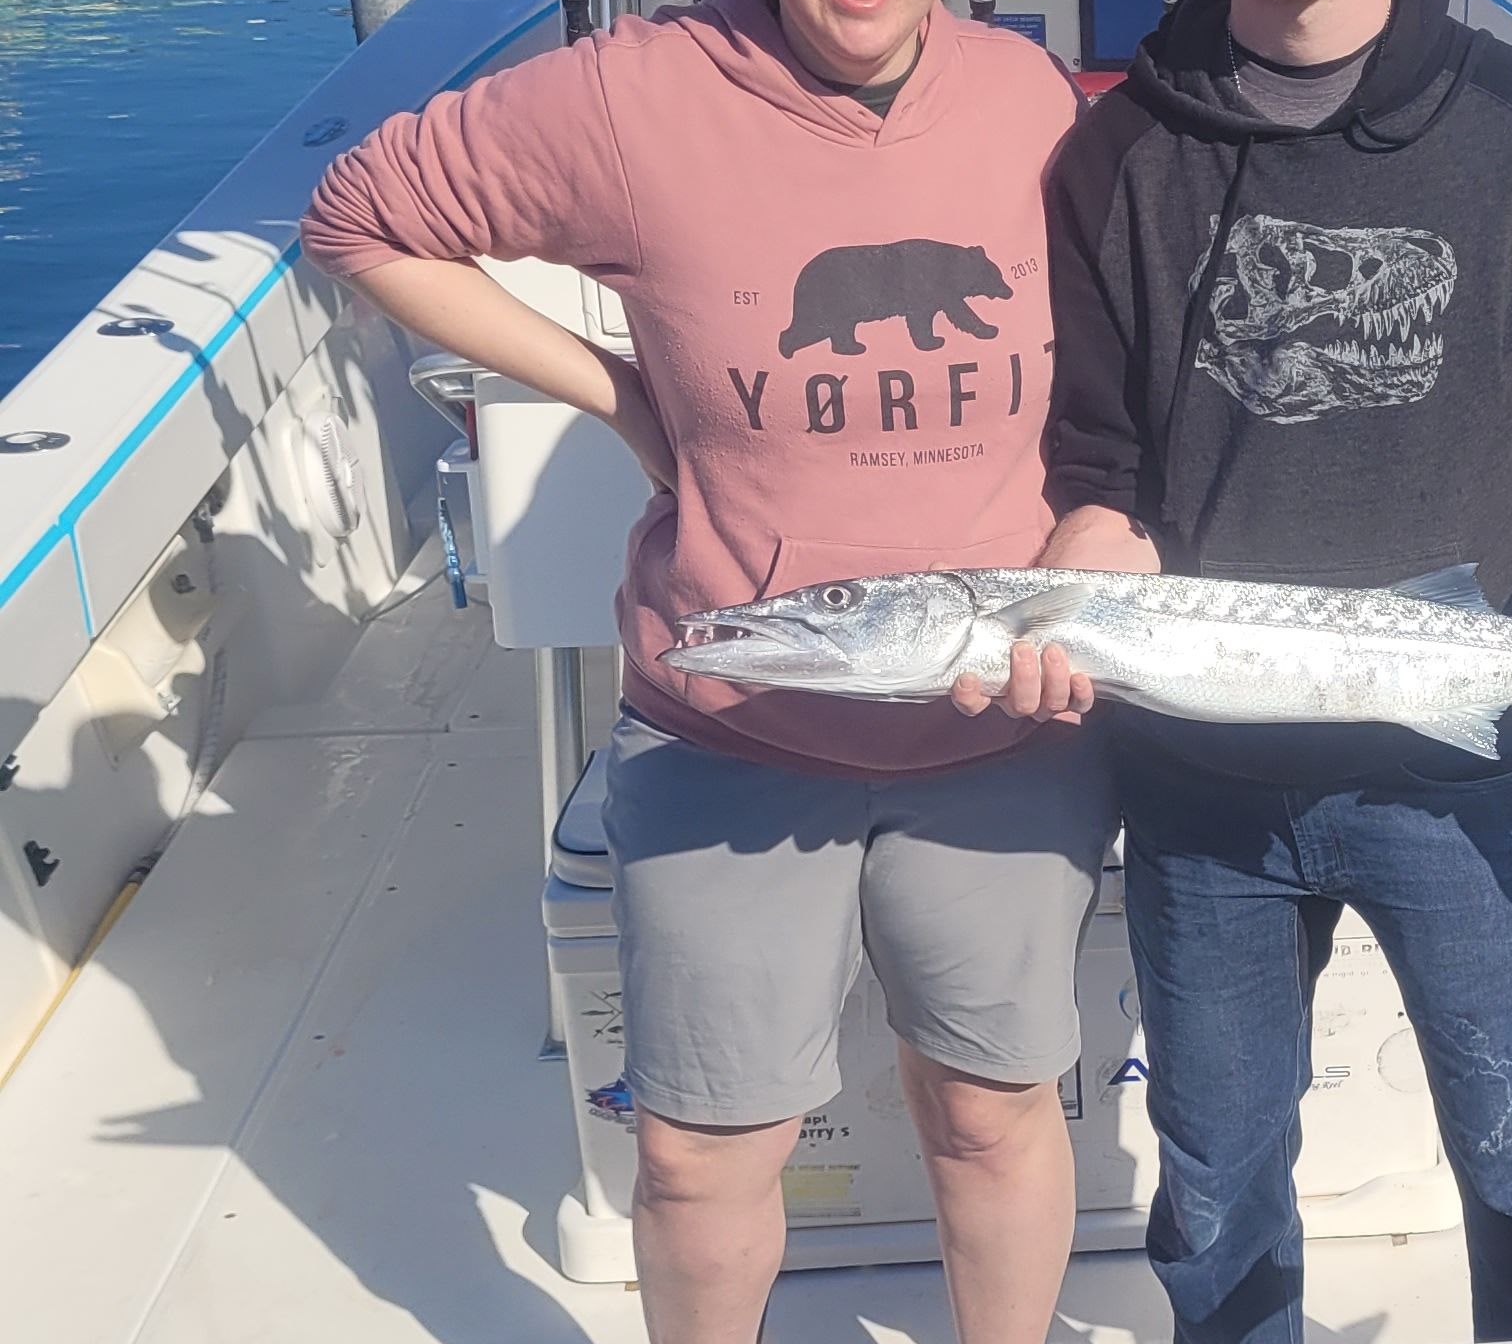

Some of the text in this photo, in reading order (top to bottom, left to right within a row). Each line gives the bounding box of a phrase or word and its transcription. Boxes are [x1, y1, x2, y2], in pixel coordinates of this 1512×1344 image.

[733, 257, 1039, 306] EST 2013
[727, 339, 1055, 434] YØRFI
[850, 443, 984, 470] RAMSEY, MINNESOTA
[799, 1127, 835, 1141] arry
